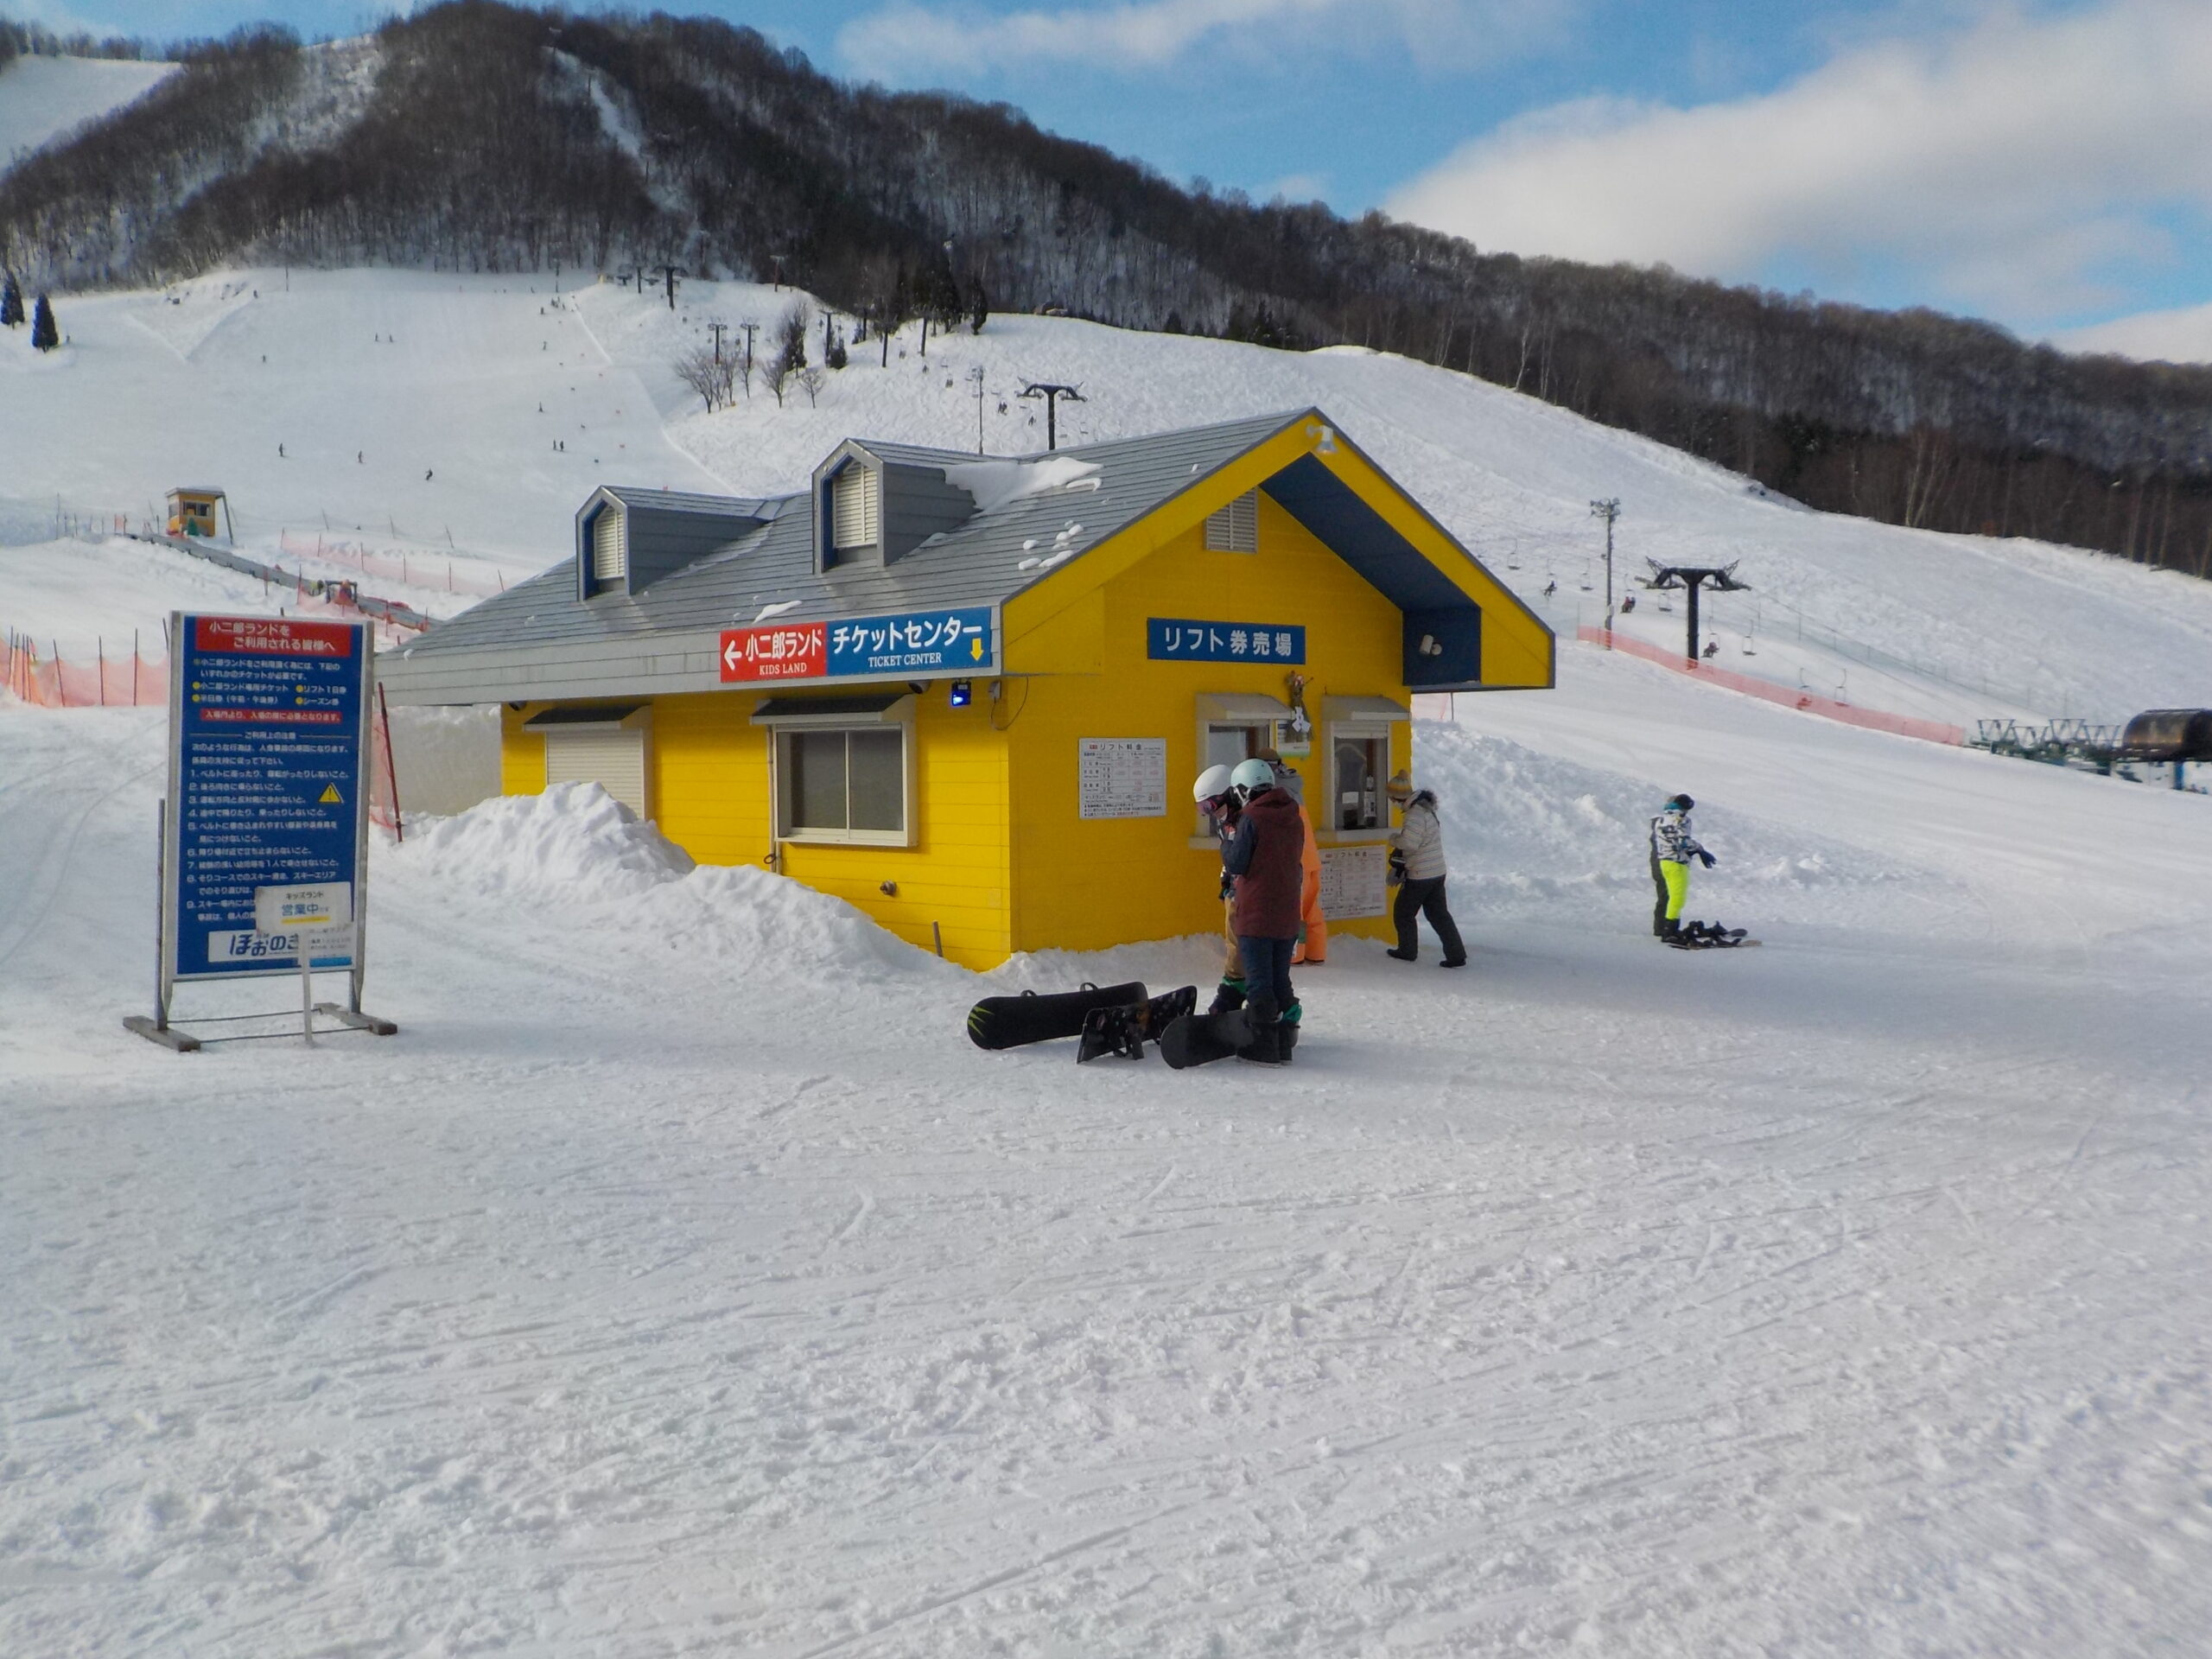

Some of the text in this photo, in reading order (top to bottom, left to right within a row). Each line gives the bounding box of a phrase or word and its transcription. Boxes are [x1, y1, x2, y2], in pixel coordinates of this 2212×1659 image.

[209, 622, 290, 638] 小二郎ランドを
[833, 616, 982, 654] チケットセンター
[233, 637, 336, 652] ご利用される皆様へ
[746, 629, 822, 663] 小二郎ランド
[1165, 626, 1293, 657] リフト券売場
[868, 652, 942, 668] TICKET CENTER
[760, 662, 807, 677] KIDS LAND
